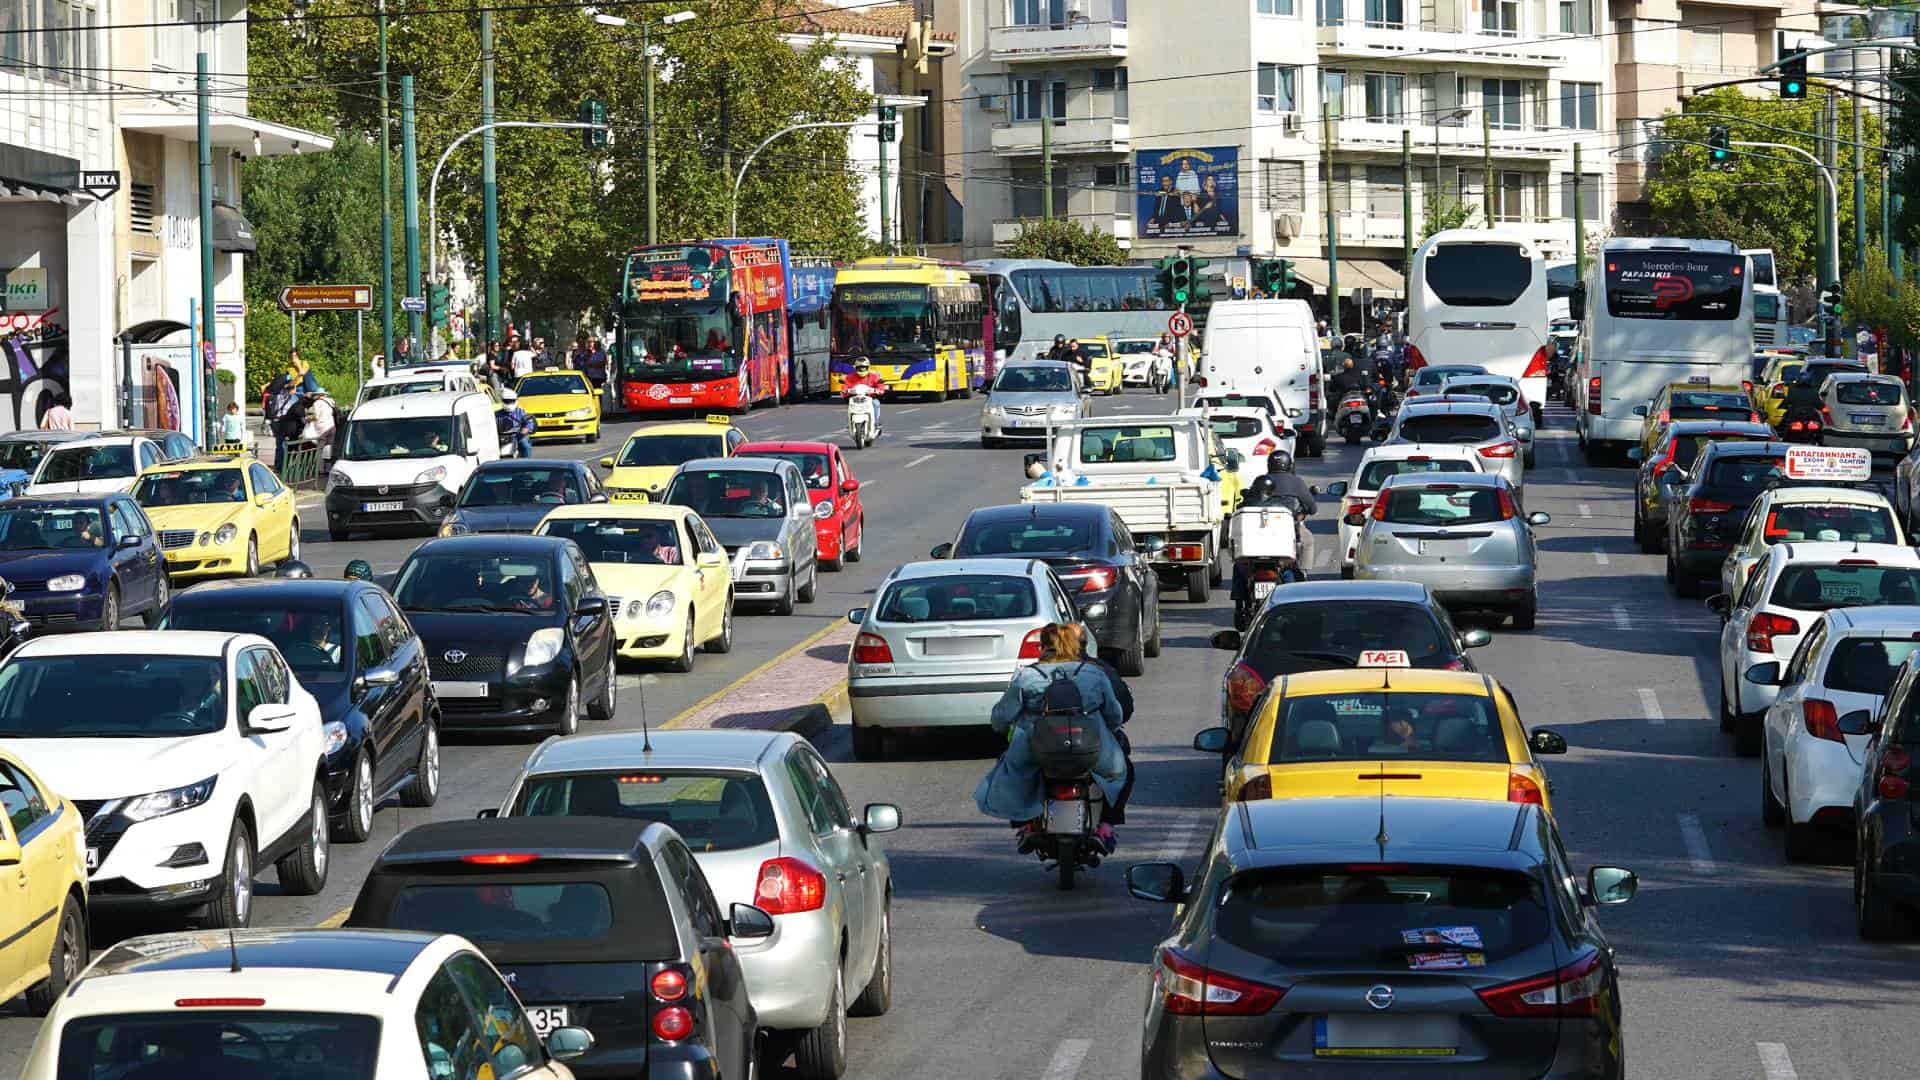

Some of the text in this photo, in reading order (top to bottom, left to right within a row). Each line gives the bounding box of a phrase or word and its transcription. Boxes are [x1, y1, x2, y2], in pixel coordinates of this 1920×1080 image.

[1642, 261, 1709, 272] Mercedes Benz
[7, 279, 37, 294] ική
[1364, 652, 1404, 664] ΤΑΞΙ
